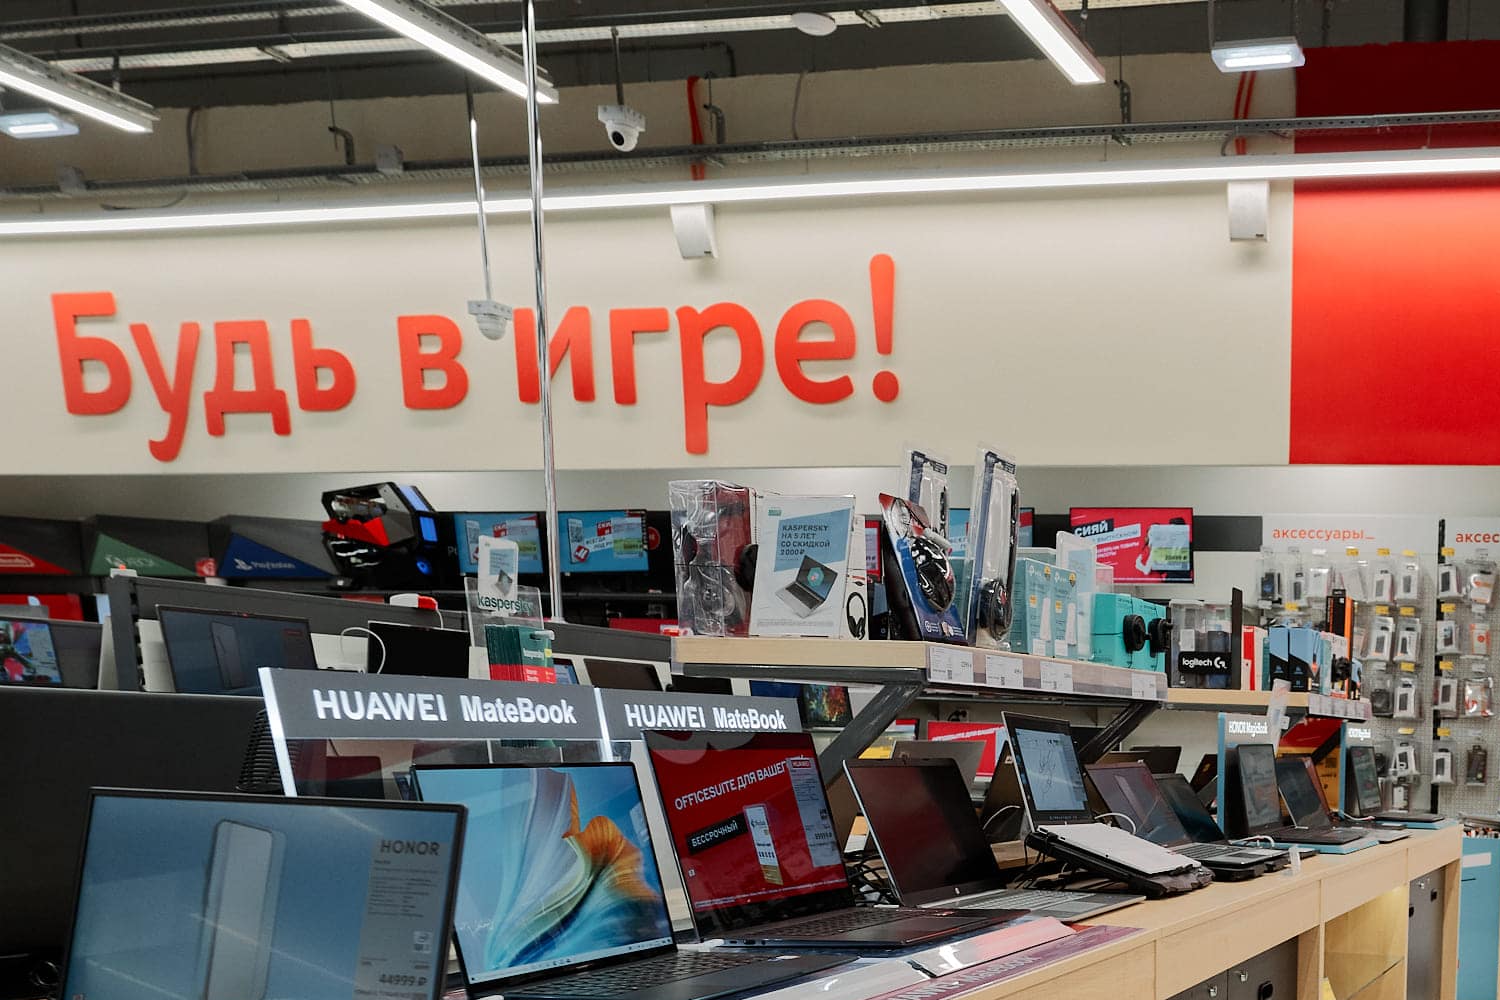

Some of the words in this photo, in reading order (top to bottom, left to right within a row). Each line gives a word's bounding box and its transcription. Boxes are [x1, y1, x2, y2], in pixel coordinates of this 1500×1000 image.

[51, 291, 357, 462] Будь
[398, 314, 469, 410] в
[513, 253, 901, 456] игре!
[782, 524, 829, 532] KASPERSKY
[800, 532, 817, 540] ЛЕТ
[1074, 520, 1109, 537] СИЯЙ
[1273, 527, 1376, 542] аксессуары_
[477, 592, 533, 617] kaspersky
[1182, 656, 1213, 669] logitech
[312, 689, 448, 722] HUAWEI
[462, 697, 577, 726] MateBook
[625, 703, 707, 730] HUAWEI
[714, 705, 788, 732] MateBook
[675, 778, 737, 811] OFFICESUITE
[737, 773, 756, 791] ДЛЯ
[691, 820, 738, 847] БЕССРОЧНЫЙ
[380, 840, 441, 856] HONOR
